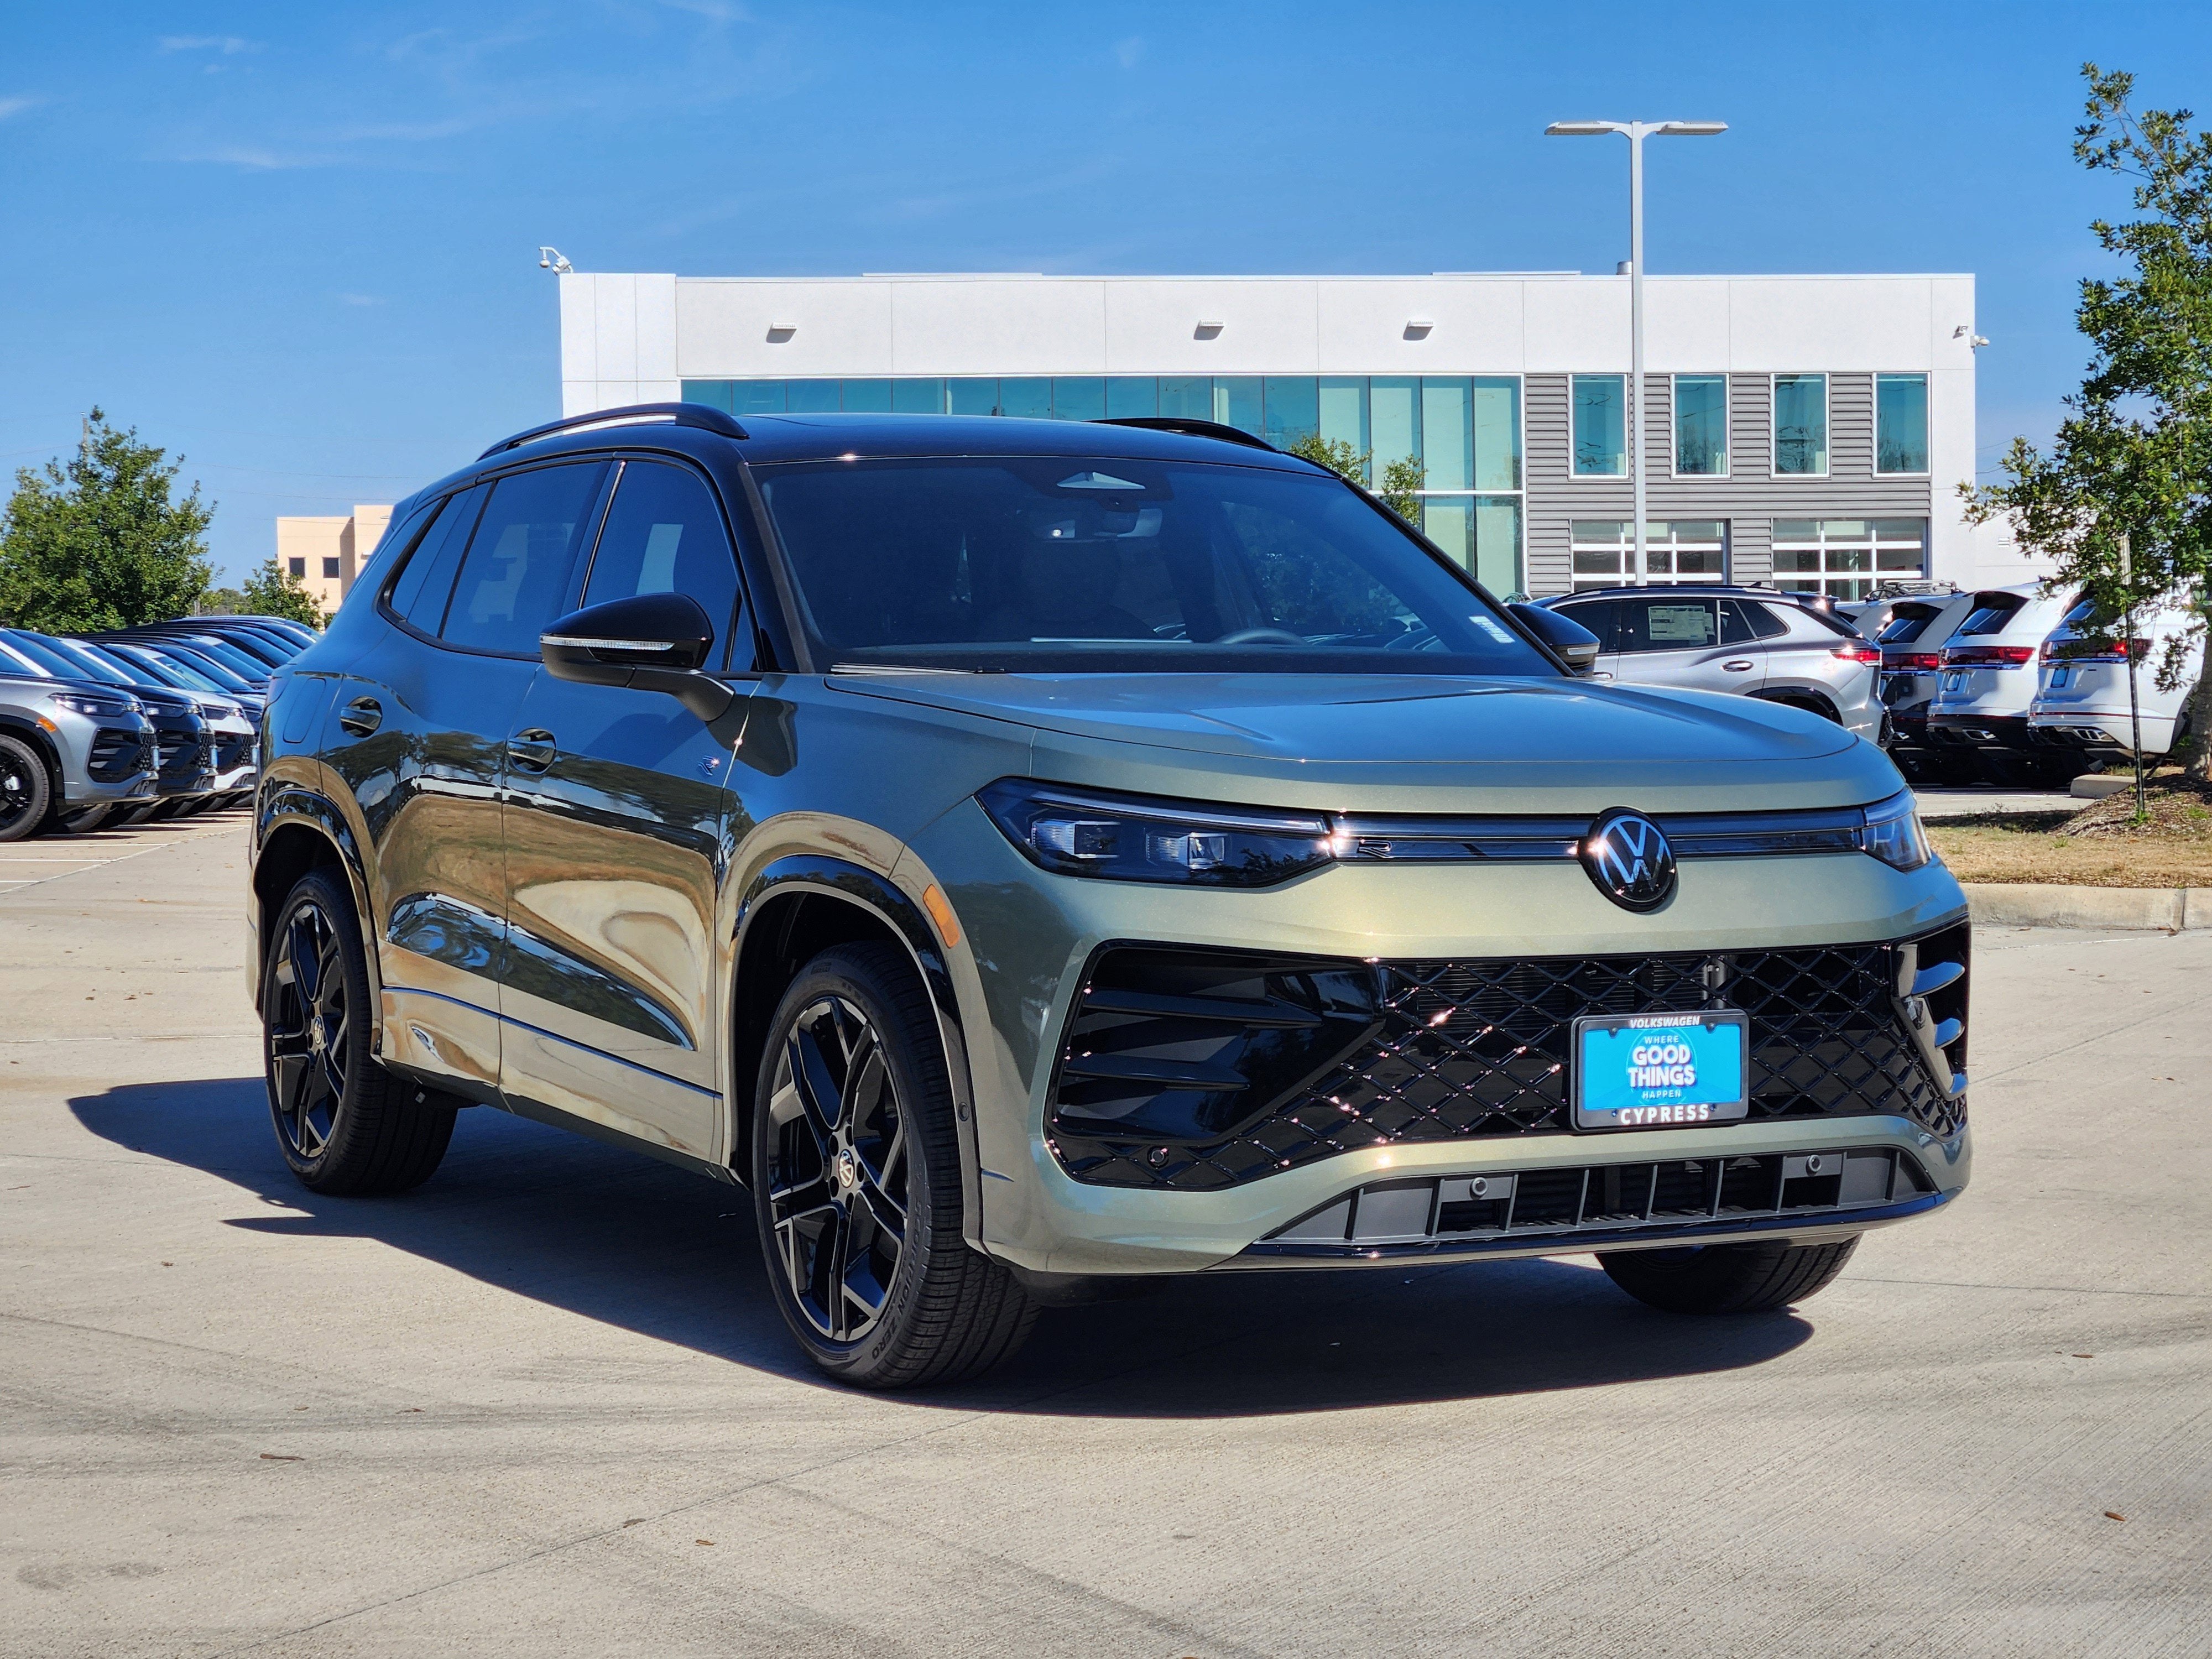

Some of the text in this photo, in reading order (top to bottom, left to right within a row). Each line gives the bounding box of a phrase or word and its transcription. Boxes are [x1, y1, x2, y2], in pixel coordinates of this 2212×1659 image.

[1629, 1016, 1700, 1029] VOLKSWAGEN
[1645, 1035, 1679, 1044] WHERE
[1632, 1045, 1691, 1065] GOOD
[1627, 1066, 1696, 1088] THINGS
[1642, 1090, 1681, 1099] HAPPEN
[1620, 1104, 1709, 1125] CYPRESS
[872, 1317, 898, 1360] ZERO
